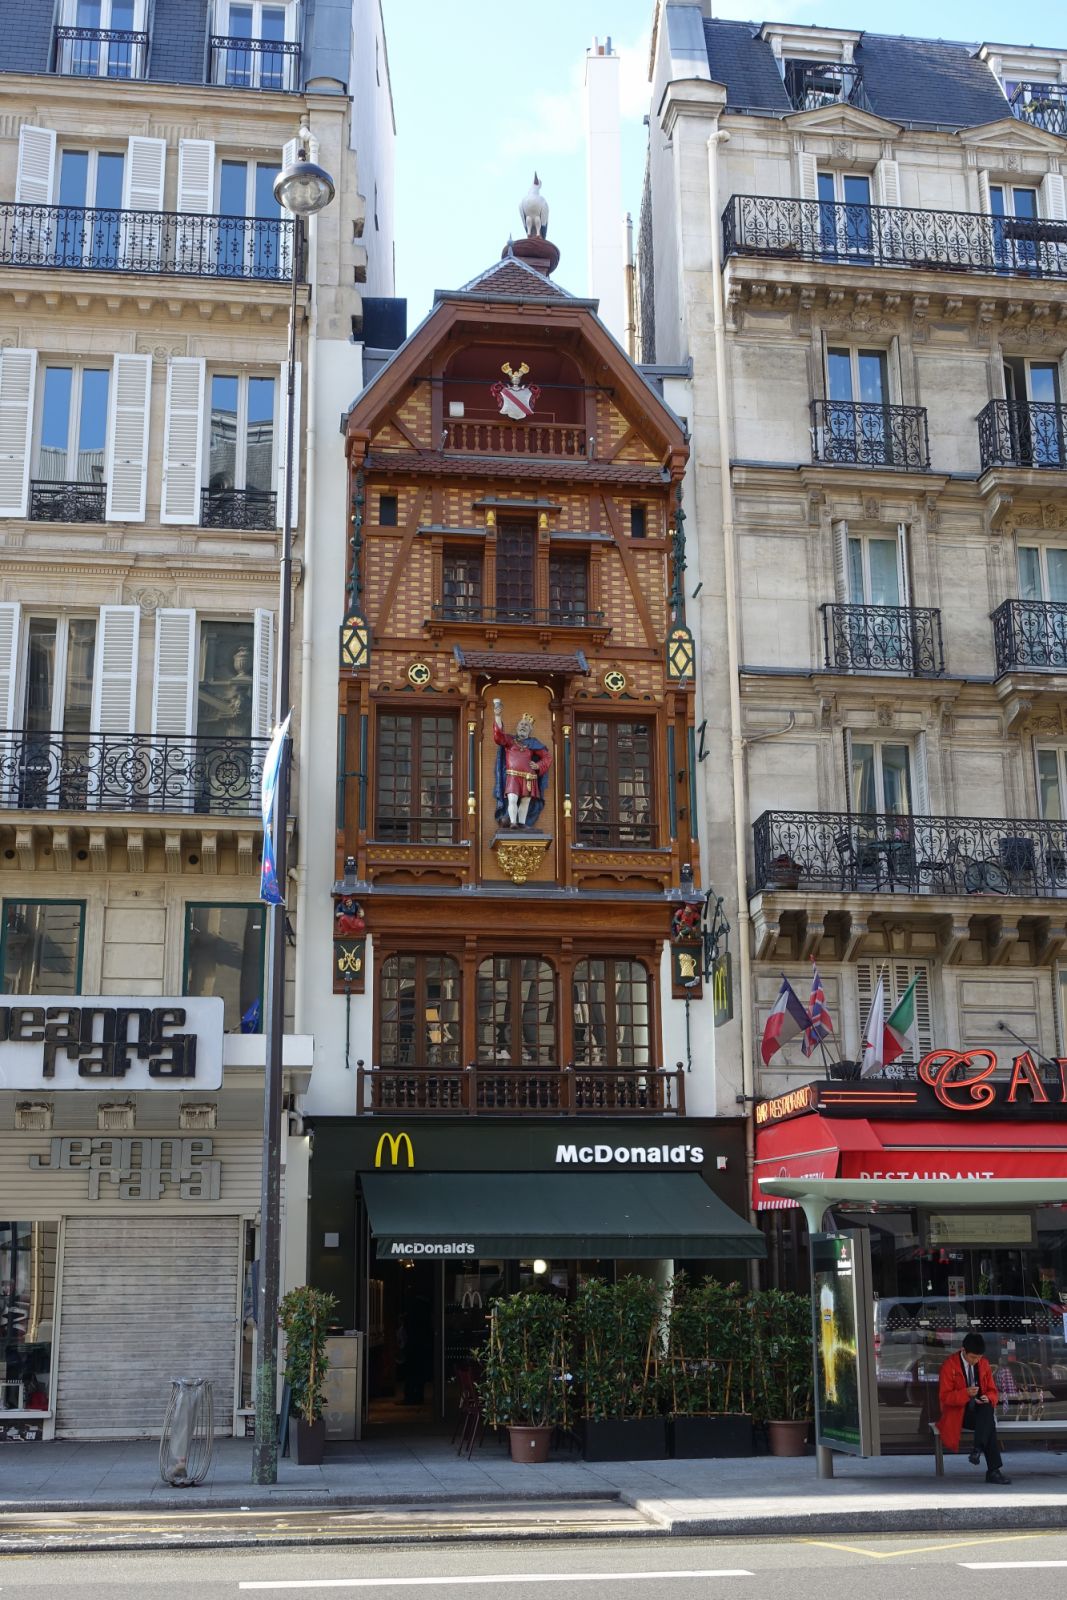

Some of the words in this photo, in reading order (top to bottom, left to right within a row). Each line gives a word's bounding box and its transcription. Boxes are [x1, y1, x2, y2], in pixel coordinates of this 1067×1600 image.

[756, 1102, 768, 1124] BAR
[555, 1144, 705, 1163] McDonald's
[391, 1242, 476, 1254] McDonald's
